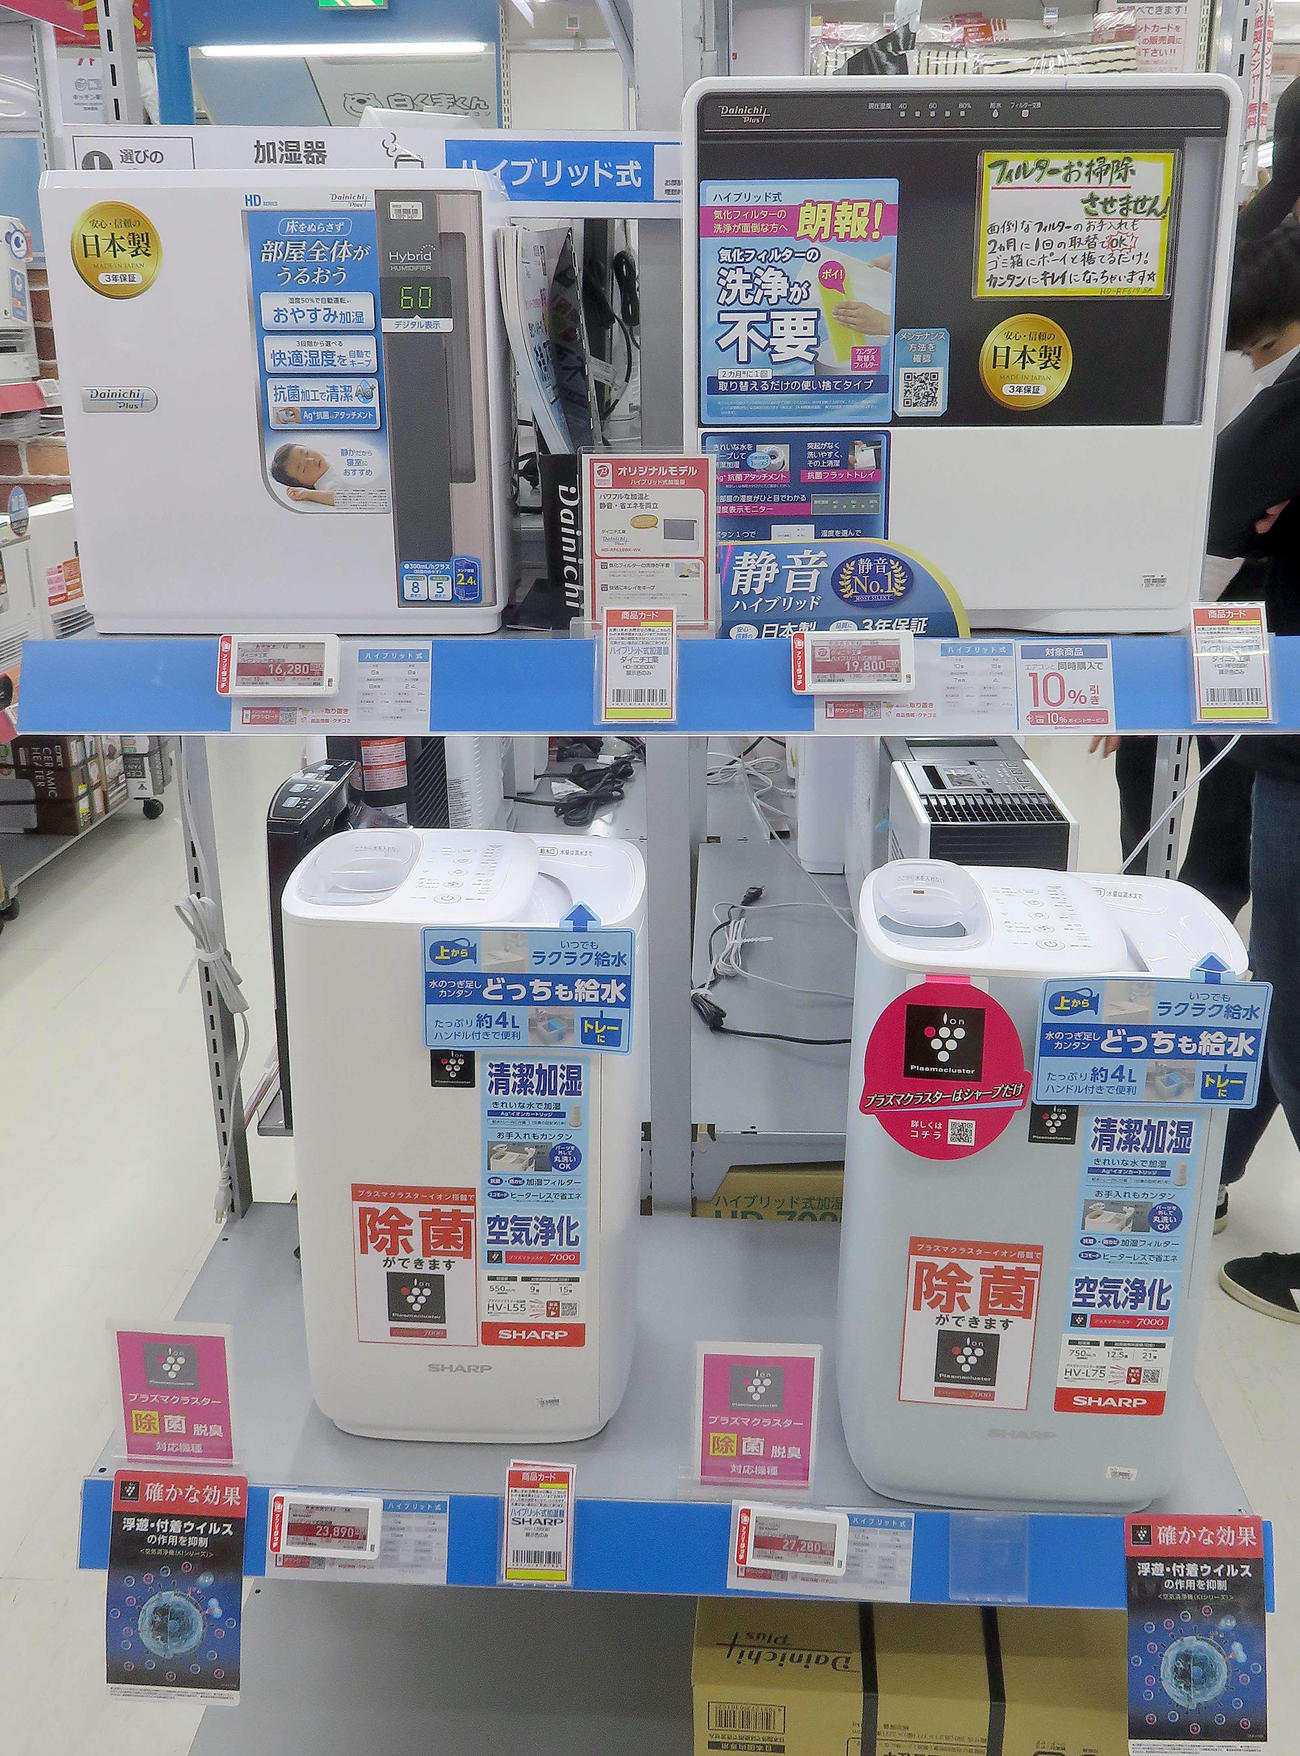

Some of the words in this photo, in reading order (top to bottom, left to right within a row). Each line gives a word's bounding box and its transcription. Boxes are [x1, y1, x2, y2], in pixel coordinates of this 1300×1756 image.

[718, 105, 764, 116] Dainichi
[119, 149, 164, 165] 選びの
[253, 139, 329, 165] 加湿器
[988, 157, 1137, 187] フィルターお掃除
[244, 194, 262, 207] HD
[329, 193, 366, 202] Dainichi
[713, 191, 783, 203] ハイブリッド式
[713, 209, 787, 220] 気化フィルターの
[796, 201, 884, 240] 朗報!
[285, 219, 346, 234] 床をぬらさず
[713, 223, 789, 235] 洗浄が面倒な方へ
[987, 219, 1139, 236] 面倒なフィルターのお手入れも
[81, 232, 154, 260] 日本製
[260, 239, 372, 263] 部屋全体が
[388, 251, 433, 264] Hybrid
[718, 247, 820, 263] 気化フィルターの
[105, 273, 138, 283] 3年保証
[277, 266, 347, 287] うるおう
[717, 266, 812, 306] 洗浄が
[399, 286, 433, 311] 60
[272, 307, 365, 324] おやすみ加湿
[394, 320, 441, 331] デジタル表示
[716, 310, 818, 364] 不要
[898, 332, 947, 342] メンテナンス
[908, 342, 936, 353] 方法を
[270, 349, 348, 368] 快適湿度を
[349, 359, 372, 368] キープ
[912, 353, 933, 364] 確認
[991, 344, 1063, 371] 日本製
[853, 362, 880, 370] フィルター
[272, 384, 354, 403] 抗菌加工で清潔
[718, 379, 874, 393] 取り替えるだけの使い捨てタイプ
[1008, 384, 1041, 395] 3年保証
[89, 388, 142, 400] Dainichi
[117, 400, 140, 410] Plus
[806, 441, 841, 450] 突起がなく
[343, 468, 373, 478] おすすめ
[617, 465, 698, 477] オリジナルモデル
[806, 470, 876, 481] 抗菌フラットトレイ
[731, 549, 829, 596] 静音
[857, 557, 889, 575] 静音
[411, 580, 421, 595] 8
[435, 580, 445, 595] 5
[852, 574, 894, 595] No.1
[731, 594, 822, 613] ハイブリッド
[621, 610, 660, 621] 商品カード
[1207, 609, 1247, 620] 商品カード
[861, 618, 929, 637] 3年保証
[1045, 647, 1084, 658] 対象商品
[620, 656, 660, 665] ダイニチ工業
[844, 660, 887, 673] 19,800
[268, 663, 310, 676] 16,280
[41, 746, 60, 799] CERAMIC
[435, 946, 470, 962] 上から
[560, 940, 600, 950] いつでも
[531, 951, 628, 969] ラクラク給水
[428, 979, 483, 991] 水のつぎ足し
[482, 975, 629, 1005] どっちも給水
[438, 988, 473, 999] カンタン
[1054, 995, 1092, 1011] 上から
[1188, 990, 1232, 1002] いつでも
[1156, 1000, 1260, 1021] ラクラク給水
[582, 1019, 620, 1034] トレー
[942, 1011, 966, 1027] Ion
[433, 1029, 522, 1042] ハンドル付きで便利
[1043, 1029, 1102, 1042] 水のつぎ足し
[1100, 1027, 1255, 1057] どっちも給水
[1053, 1039, 1092, 1051] カンタン
[909, 1063, 977, 1077] Plasmacluster
[487, 1062, 583, 1098] 清潔加湿
[1202, 1072, 1246, 1089] トレー
[864, 1082, 1027, 1110] プラズマクラスターはシャープだけ
[1044, 1083, 1139, 1097] ハンドル付きで便利
[491, 1101, 562, 1111] きれいな水で加湿
[910, 1119, 943, 1130] 詳しくは
[496, 1132, 574, 1143] お手入れもカンタン
[909, 1130, 943, 1140] コチラ
[1090, 1117, 1194, 1155] 清潔加湿
[1093, 1157, 1168, 1169] きれいな水で加湿
[525, 1178, 582, 1187] 加湿フィルター
[509, 1191, 582, 1201] ヒーターレスで省エネ
[1094, 1189, 1177, 1201] お手入れもカンタン
[358, 1205, 474, 1260] 除菌
[486, 1213, 581, 1248] 空気浄化
[1120, 1238, 1180, 1249] 加湿フィルター
[382, 1256, 457, 1272] ができます
[1102, 1252, 1179, 1263] ヒーターレスで省エネ
[912, 1260, 1040, 1321] 除菌
[1071, 1275, 1174, 1312] 空気浄化
[487, 1303, 528, 1313] HV-L55
[935, 1313, 1015, 1332] ができます
[498, 1329, 569, 1341] SHARP
[427, 1363, 494, 1375] SHARP
[1064, 1368, 1107, 1380] HV-L75
[128, 1391, 223, 1408] プラズマクラスター
[1072, 1395, 1149, 1410] SHARP
[707, 1415, 805, 1429] プラズマクラスター
[987, 1427, 1059, 1441] SHARP
[143, 1481, 243, 1508] 確かな効果
[122, 1516, 235, 1538] 浮遊・付着ウイルス
[315, 1525, 356, 1540] 23,890
[1157, 1523, 1258, 1549] 確かな効果
[781, 1539, 823, 1554] 27,280
[736, 1646, 860, 1674] Dainichi
